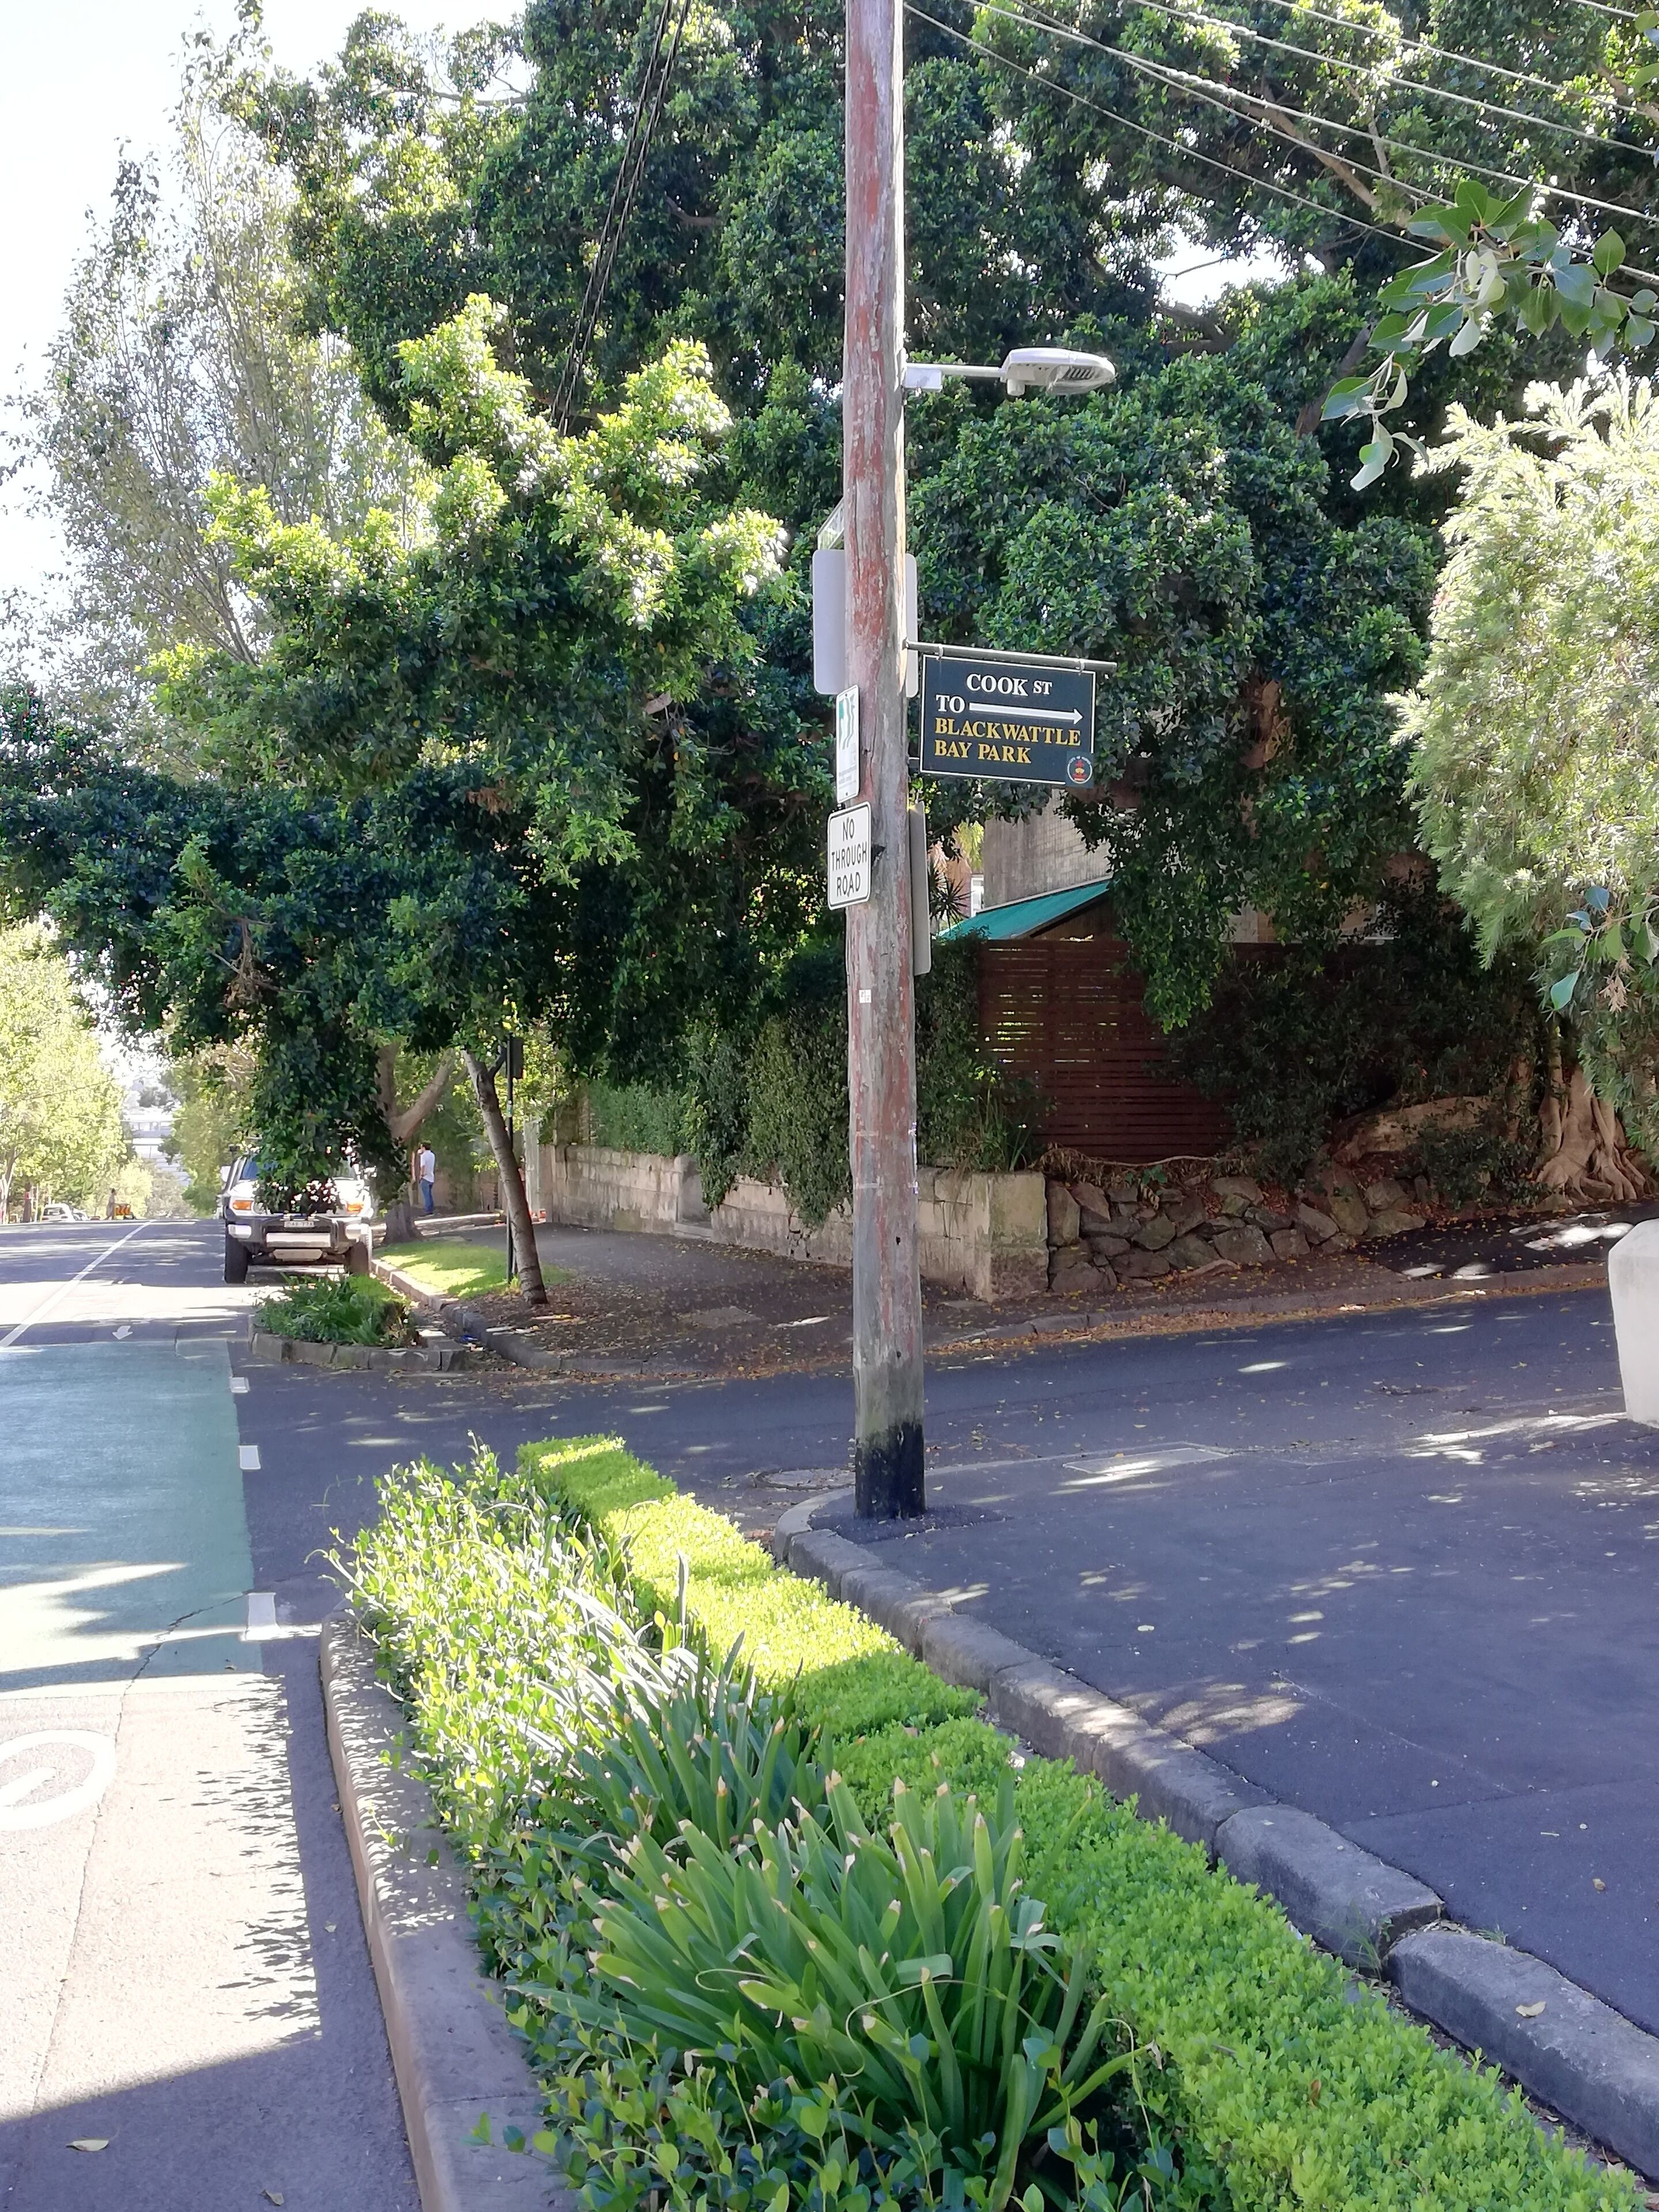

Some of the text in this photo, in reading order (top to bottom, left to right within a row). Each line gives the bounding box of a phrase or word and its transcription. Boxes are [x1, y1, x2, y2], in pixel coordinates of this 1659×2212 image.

[966, 673, 1052, 696] COOK ST
[935, 694, 965, 713] TO
[935, 718, 1081, 746] BLACKWATTLE
[934, 740, 1031, 764] BAY PARK
[843, 817, 855, 842] NO
[831, 841, 867, 872] THROUGH
[836, 872, 861, 897] ROAD
